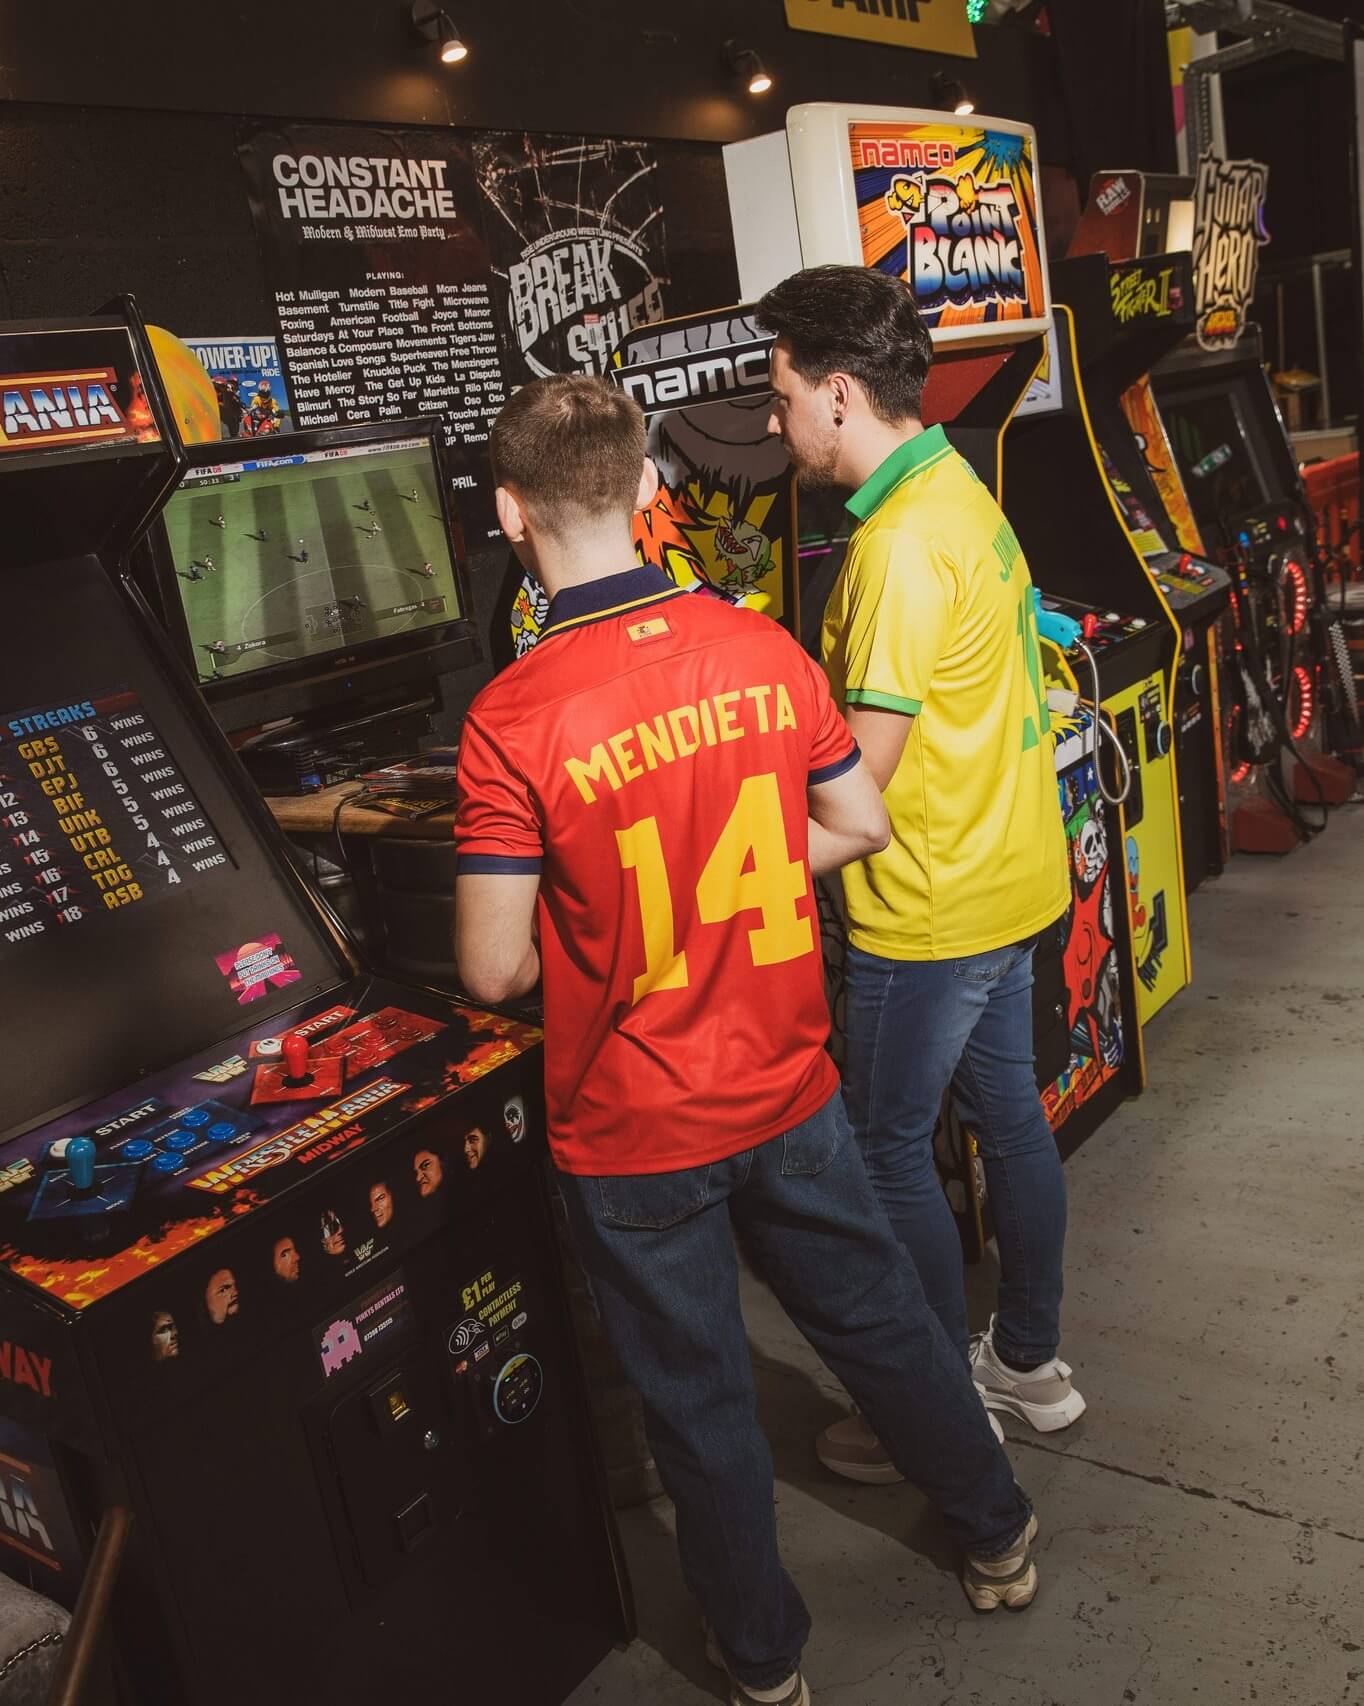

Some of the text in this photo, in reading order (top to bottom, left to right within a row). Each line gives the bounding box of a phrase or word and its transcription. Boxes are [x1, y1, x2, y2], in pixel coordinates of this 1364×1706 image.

[861, 139, 955, 168] namco
[273, 154, 447, 188] CONSTANT
[278, 188, 456, 219] HEADACHE
[302, 225, 342, 240] Modern
[354, 224, 397, 239] Midwest
[398, 225, 417, 238] Emo
[419, 224, 446, 241] Party
[912, 226, 1025, 297] BLANK
[366, 271, 405, 281] PLAYING:
[275, 283, 487, 302] Hot Mulligan Modern Baseball Mom Jeans
[278, 295, 489, 316] Basement Turnstile Title Fight Microwave
[509, 238, 622, 353] BREAK
[280, 308, 491, 330] Foxing American Football Joyce Manor
[283, 321, 493, 344] Saturdays At Your Place The Front Bottoms
[190, 345, 279, 370] OWER-UP!
[286, 333, 495, 358] Balance & Composure Movements Tigers Jaw
[289, 345, 497, 373] Spanish Love Songs Superheaven Free Throw
[261, 368, 280, 377] RIDE
[291, 358, 499, 385] The Hotelier Knuckle Puck The Menzingers
[294, 369, 501, 399] Have Mercy The Get Up Kids La Dispute
[622, 349, 775, 405] namc
[337, 381, 503, 408] The Story So Far Marietta Rilo Kiley
[0, 385, 121, 434] ANIA
[300, 394, 505, 426] Michael Cera Palin Citizen Oso Oso
[448, 406, 504, 420] Touche Amor
[454, 422, 475, 433] Eyes
[463, 433, 488, 443] Remo
[195, 468, 212, 476] FIFA
[256, 458, 293, 469] FIFA.com
[451, 475, 477, 490] PRIL
[8, 701, 97, 738] STREAKS
[17, 714, 145, 760] GBS 6 WINS
[564, 684, 798, 805] MENDIETA
[28, 731, 155, 779] DJT 6 WINS
[102, 761, 119, 777] 6
[130, 749, 165, 766] WINS
[52, 766, 176, 816] BIF 5 WINS
[122, 796, 139, 813] 5
[151, 784, 186, 801] WINS
[7, 811, 29, 828] 13
[69, 801, 196, 853] UTB 5 WINS
[18, 829, 41, 847] 14
[83, 818, 206, 871] CRL 4 WINS
[28, 848, 50, 865] 15
[91, 836, 216, 891] TDG 4 WINS
[167, 868, 182, 884] 4
[192, 853, 226, 872] WINS
[39, 868, 62, 885] 16
[615, 772, 815, 1007] 14
[52, 886, 69, 904] 17
[62, 905, 83, 923] 18
[5, 921, 45, 943] WINS
[295, 1010, 344, 1038] START
[96, 1104, 158, 1136] START
[190, 1080, 402, 1192] WRESTLEMANIA
[298, 1123, 364, 1164] MIDWAY
[462, 1271, 493, 1312] £1 PER
[478, 1282, 522, 1321] CONTACTLESS
[482, 1281, 496, 1297] PLAY
[488, 1299, 518, 1327] PAYMENT
